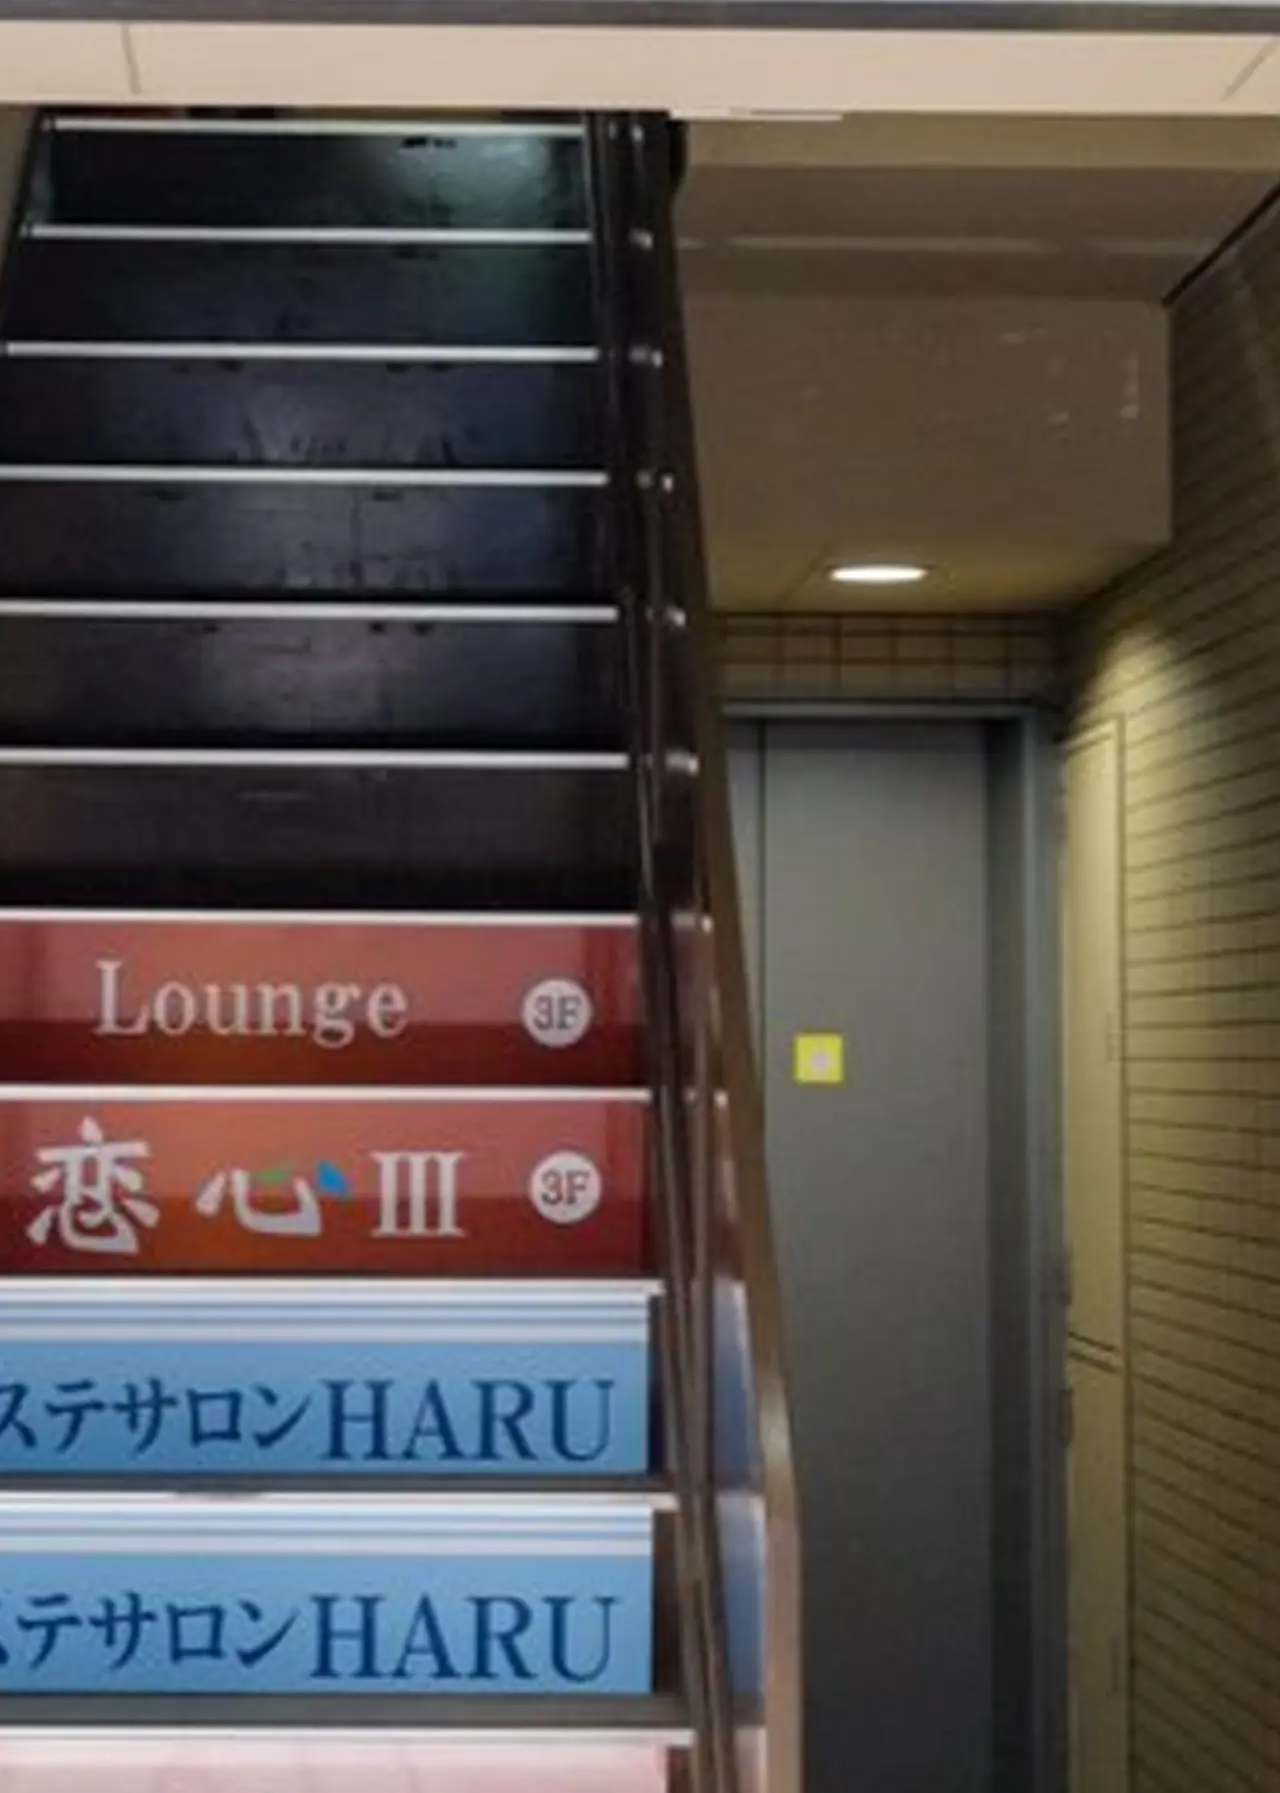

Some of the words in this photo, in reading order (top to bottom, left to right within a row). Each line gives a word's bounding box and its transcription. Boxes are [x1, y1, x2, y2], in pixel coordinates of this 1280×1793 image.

[93, 959, 410, 1048] Lounge
[532, 994, 582, 1033] 3F
[539, 1169, 591, 1207] 3F
